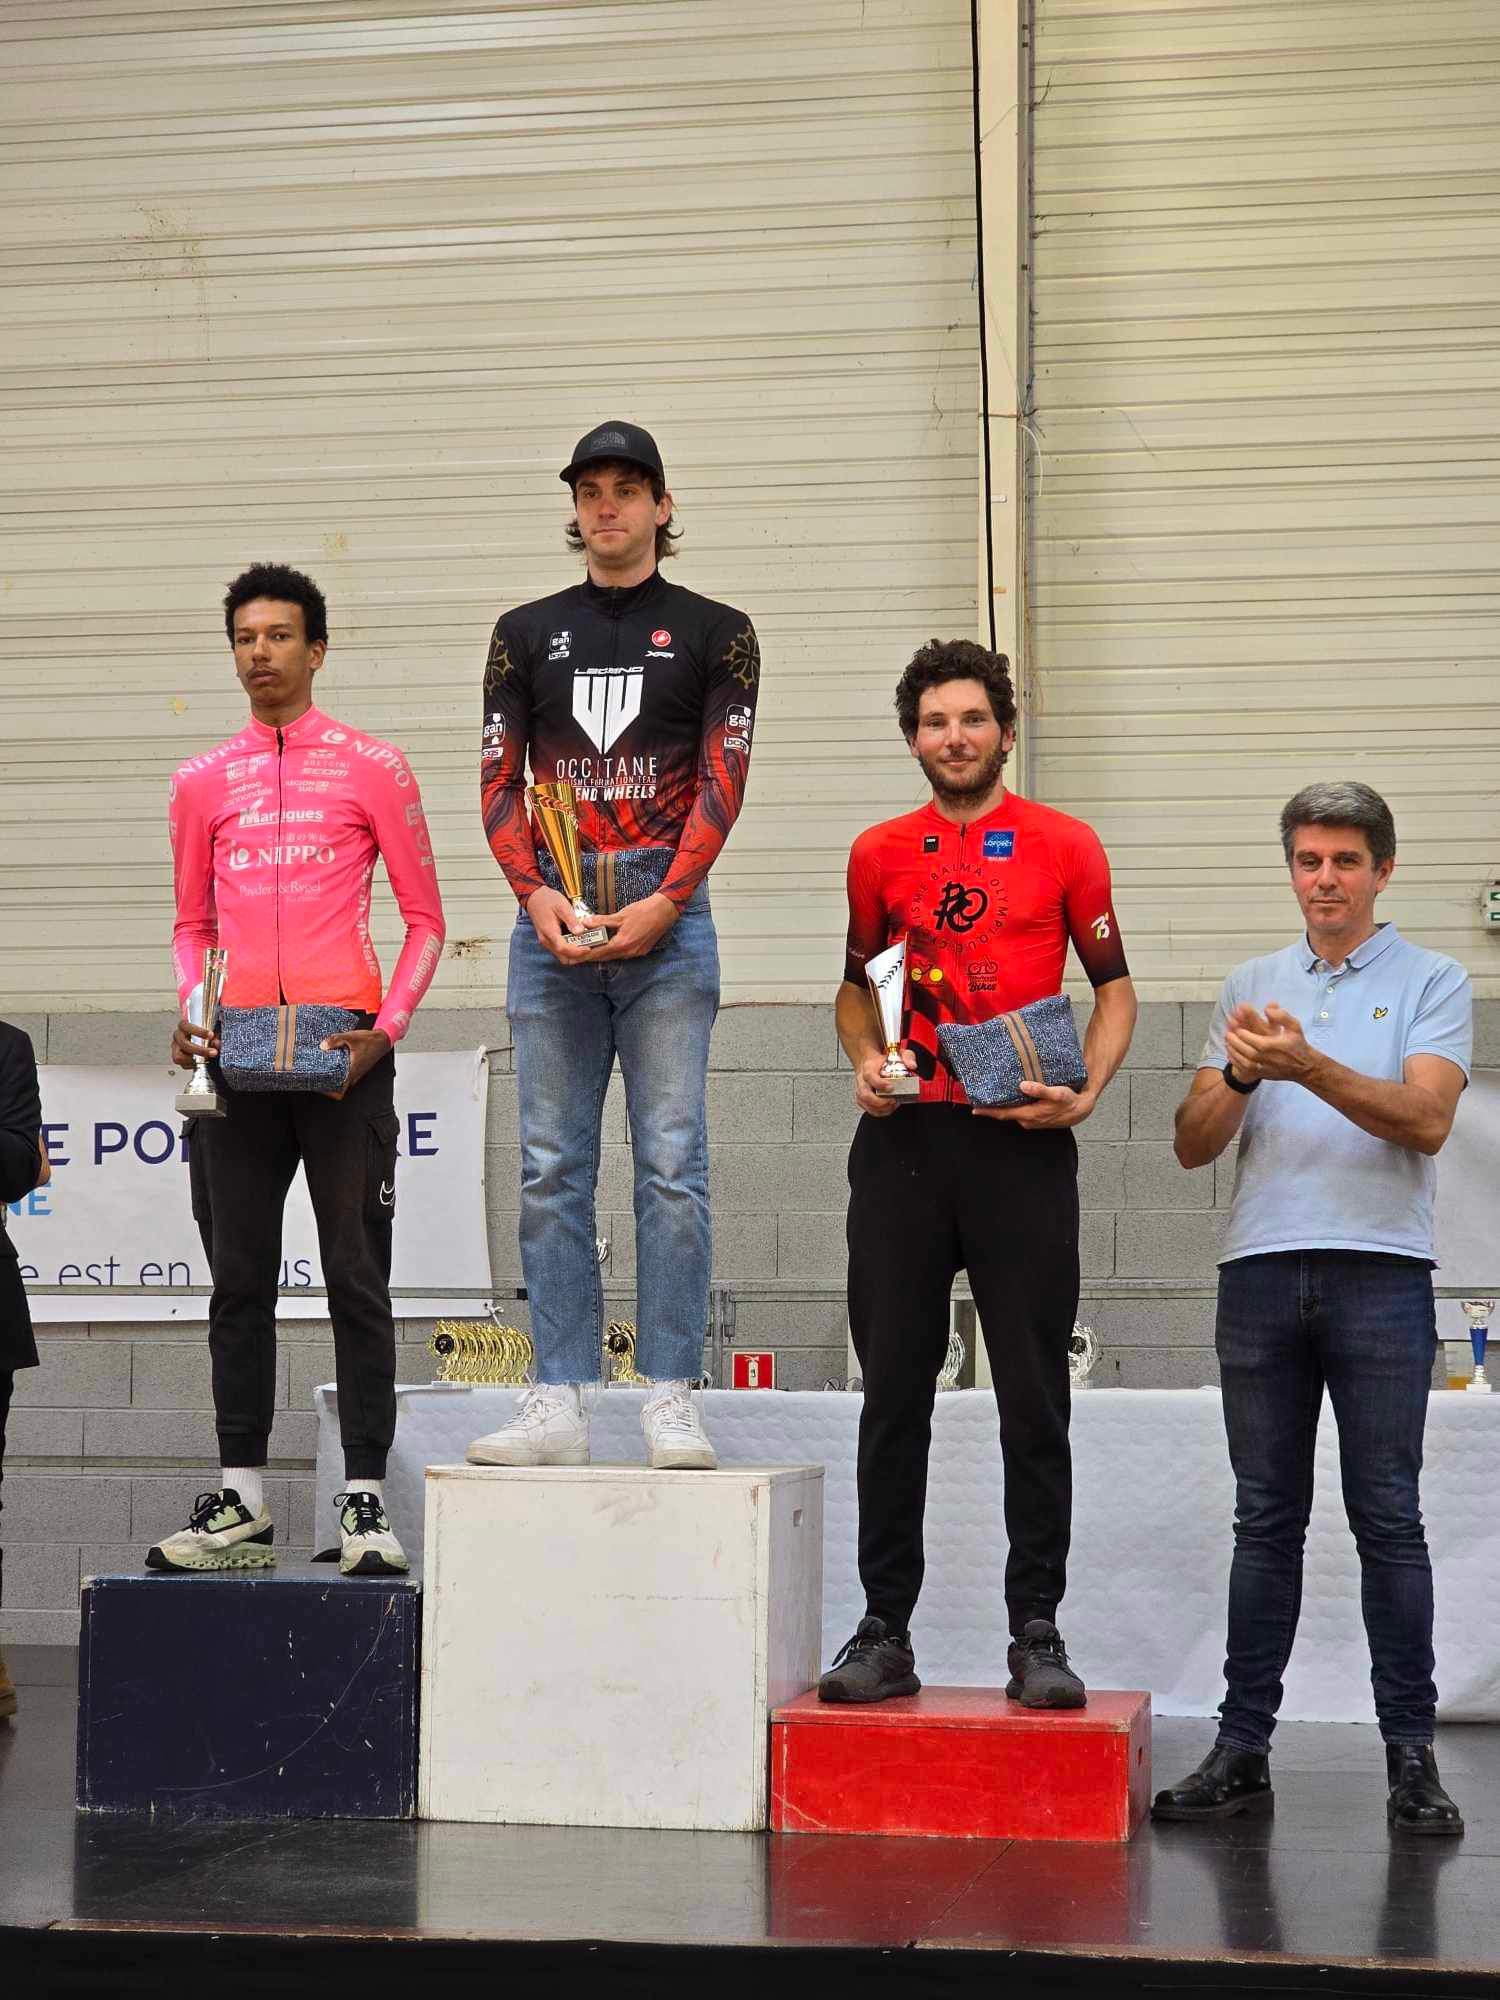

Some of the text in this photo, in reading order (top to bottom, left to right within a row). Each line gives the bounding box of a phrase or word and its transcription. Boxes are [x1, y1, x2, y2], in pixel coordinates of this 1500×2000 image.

[574, 666, 645, 675] LEGEND
[484, 723, 503, 738] gan
[178, 739, 248, 779] NIPPO
[348, 740, 410, 788] NIPPO
[556, 756, 657, 779] OCCITANE
[603, 785, 657, 802] WHEELS
[256, 845, 336, 867] NIPPO
[58, 1256, 120, 1286] est
[139, 1261, 190, 1287] en
